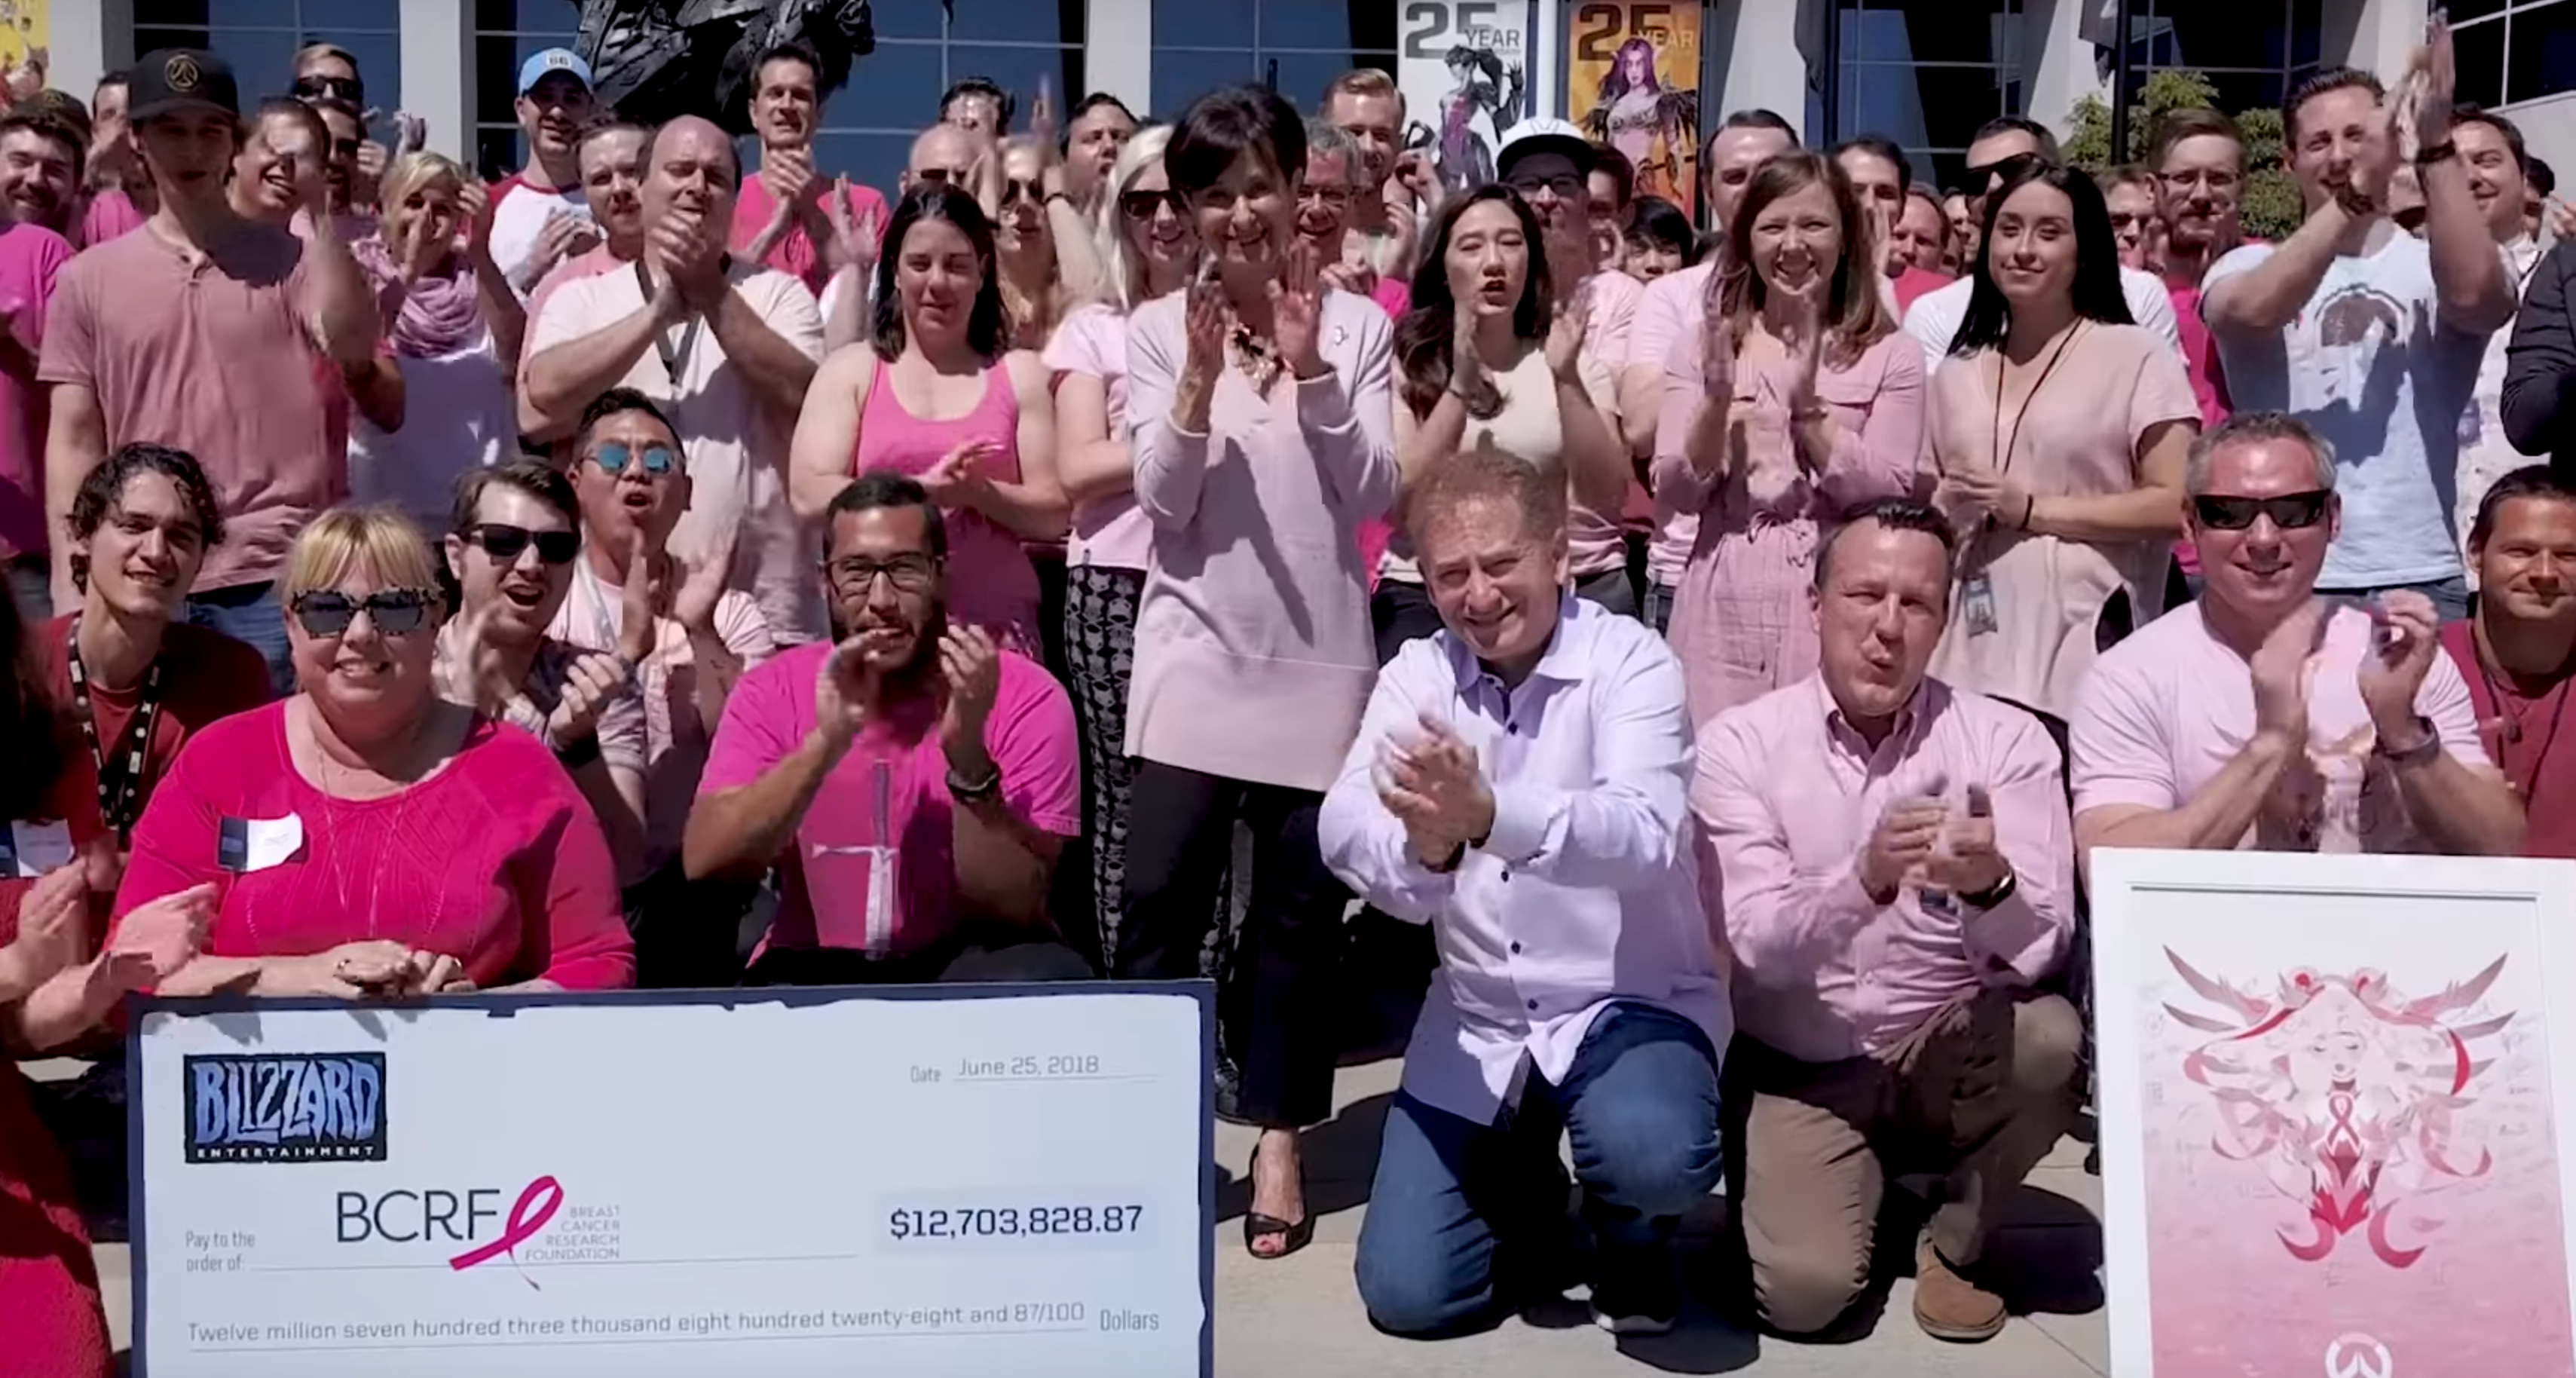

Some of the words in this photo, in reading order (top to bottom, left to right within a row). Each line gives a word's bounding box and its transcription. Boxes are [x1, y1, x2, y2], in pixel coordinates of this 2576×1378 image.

[1405, 2, 1497, 58] 25
[1464, 29, 1520, 47] YEAR
[1578, 4, 1671, 61] 25
[1638, 30, 1693, 48] YEAR
[910, 1065, 941, 1082] Date
[958, 1058, 1005, 1076] June
[1011, 1056, 1042, 1076] 25,
[1048, 1055, 1100, 1074] 2018
[191, 1058, 379, 1144] BLIZZARD
[197, 1146, 375, 1159] ENTERTAINMENT
[336, 1188, 500, 1243] BCRF
[570, 1205, 620, 1218] BREAST
[560, 1220, 620, 1233] CANCER
[890, 1205, 1143, 1240] $12,703,828.87
[185, 1230, 210, 1251] Pay
[213, 1232, 228, 1247] to
[232, 1231, 255, 1247] the
[546, 1234, 620, 1247] RESEARCH
[186, 1254, 222, 1272] order
[227, 1252, 246, 1272] of:
[525, 1248, 620, 1261] FOUNDATION
[189, 1322, 259, 1341] Twelve
[267, 1321, 336, 1340] million
[343, 1322, 405, 1339] seven
[413, 1318, 500, 1337] hundred
[507, 1318, 564, 1335] three
[571, 1315, 671, 1334] thousand
[678, 1313, 730, 1334] eight
[738, 1310, 825, 1329] hundred
[831, 1307, 963, 1329] twenty-eight
[970, 1305, 1008, 1323] and
[1014, 1302, 1085, 1324] 87/100
[1099, 1309, 1159, 1331] Dollars
